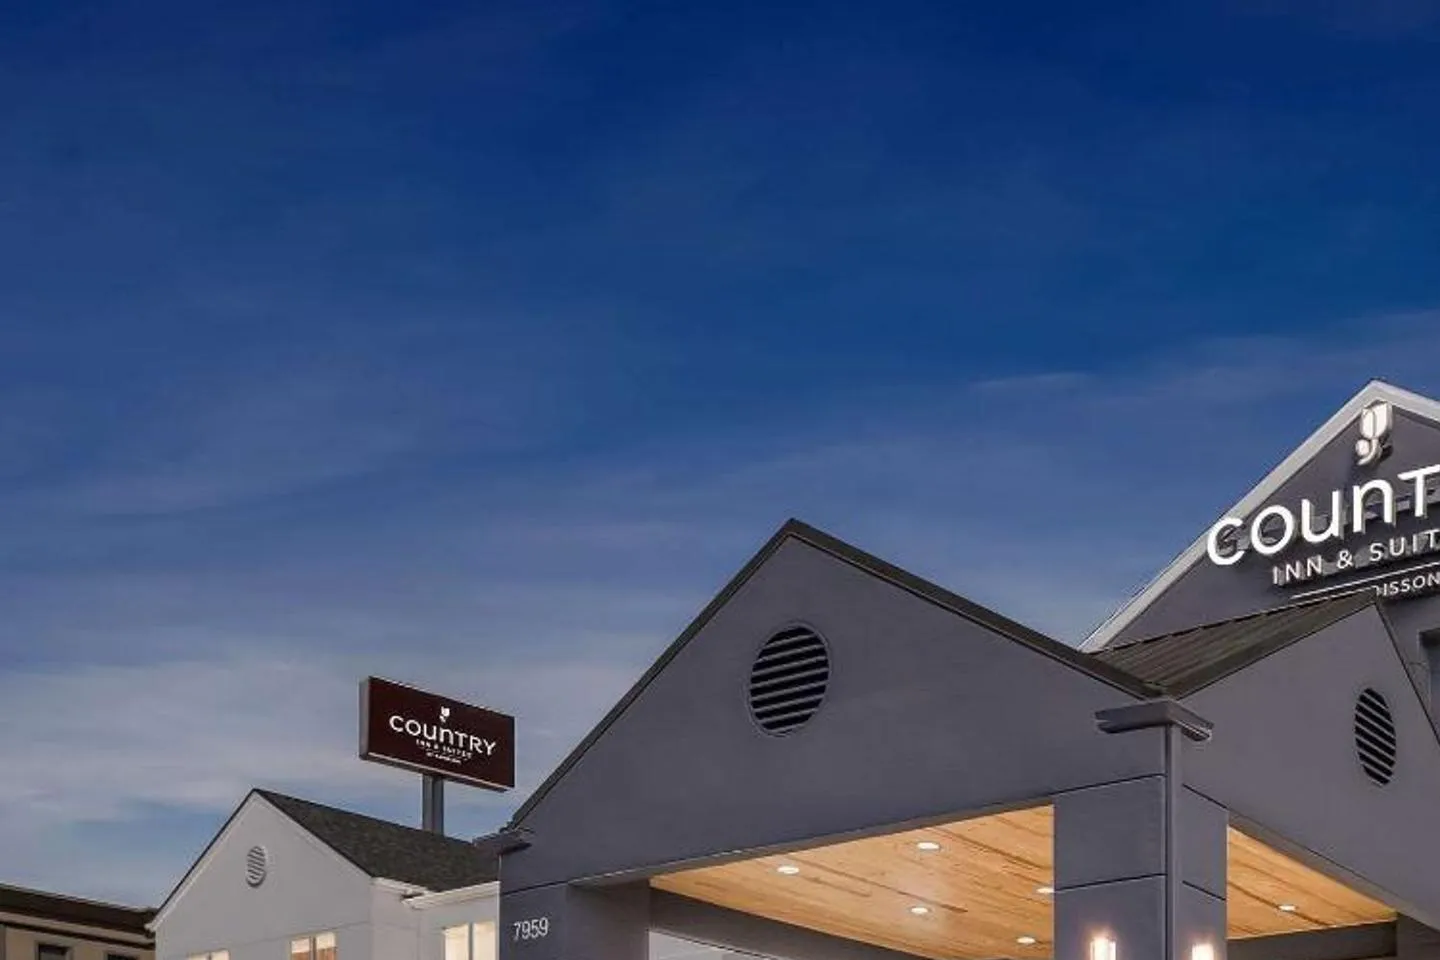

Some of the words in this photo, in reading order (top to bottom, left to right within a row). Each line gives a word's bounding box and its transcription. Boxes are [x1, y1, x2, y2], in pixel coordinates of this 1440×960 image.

[1272, 554, 1323, 585] INN
[1337, 549, 1354, 570] &
[1376, 571, 1440, 597] ISSON
[388, 715, 496, 756] COUNTRY
[513, 916, 549, 941] 7959
